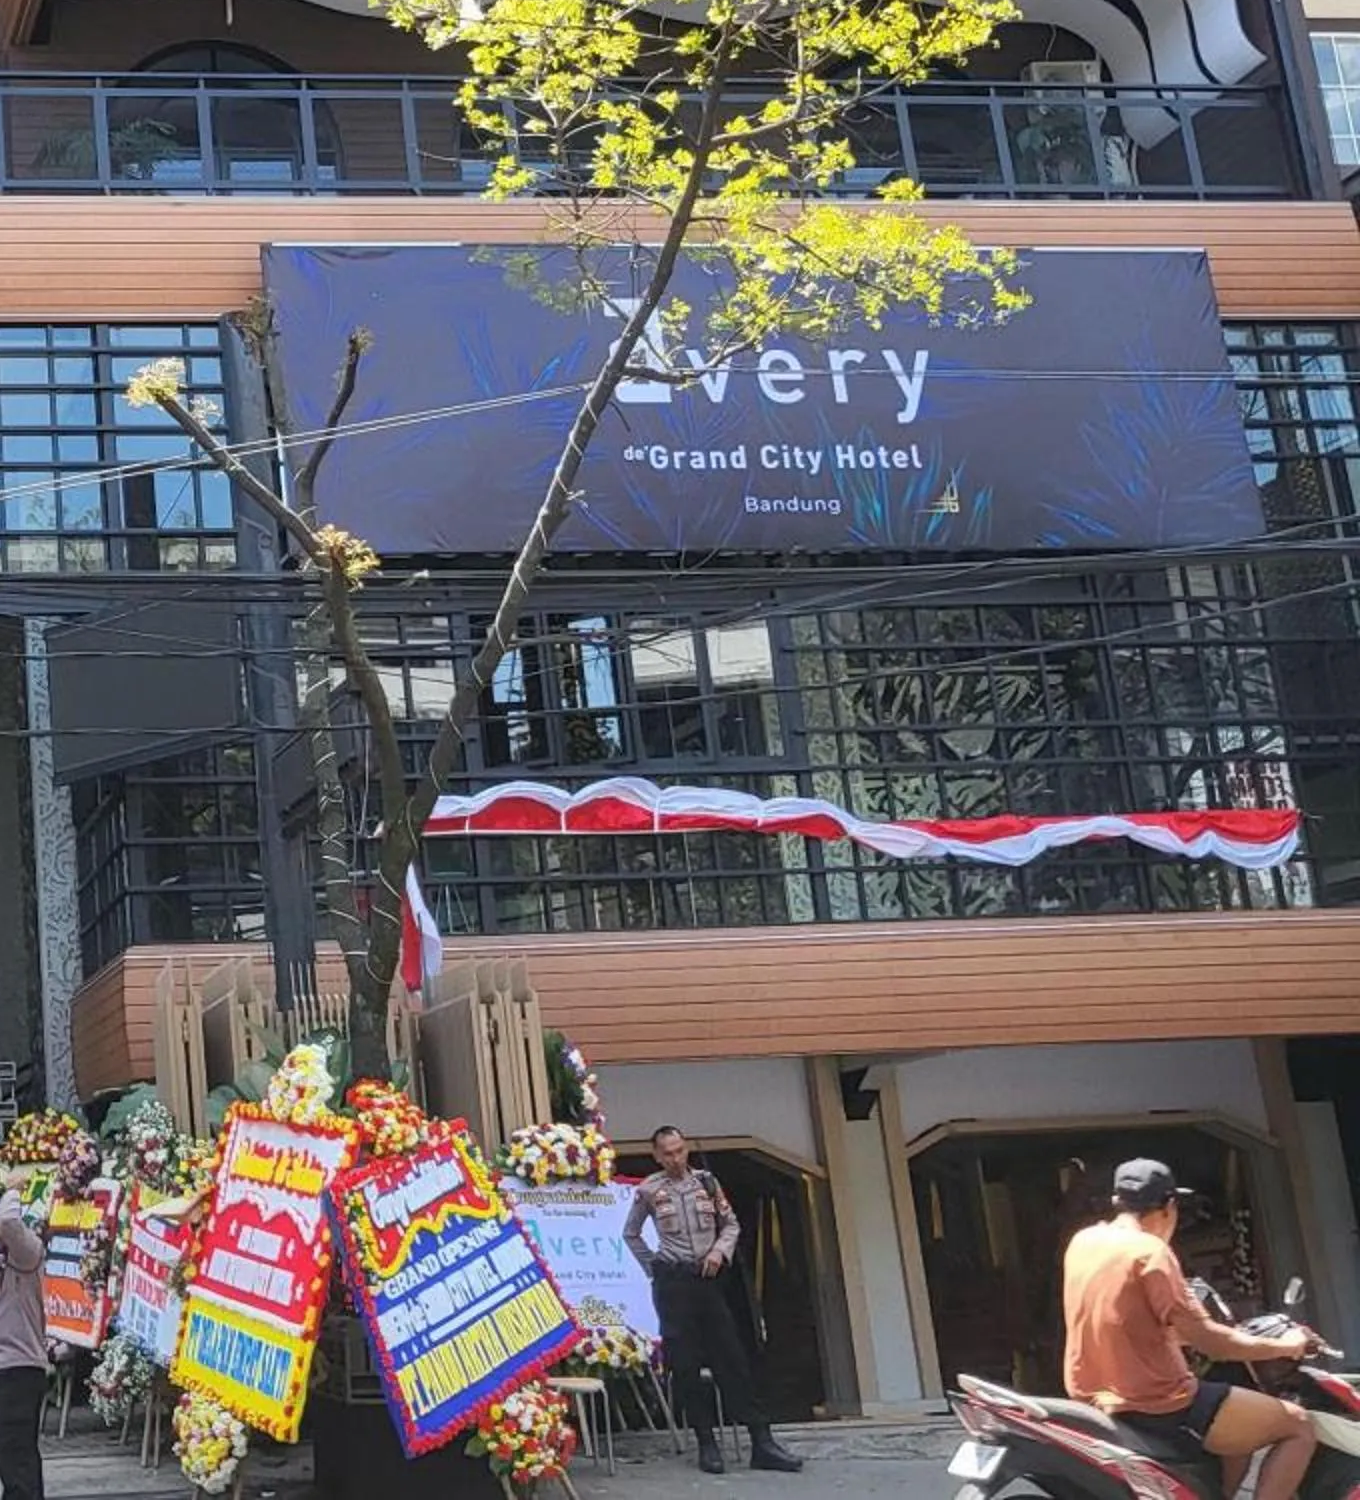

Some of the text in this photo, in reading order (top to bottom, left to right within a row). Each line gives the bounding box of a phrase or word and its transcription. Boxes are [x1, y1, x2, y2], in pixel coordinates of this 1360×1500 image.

[760, 445, 822, 475] City
[837, 445, 923, 470] Hotel
[745, 497, 841, 514] Bandung
[384, 1256, 440, 1298] GRAND
[440, 1219, 501, 1267] OPENING
